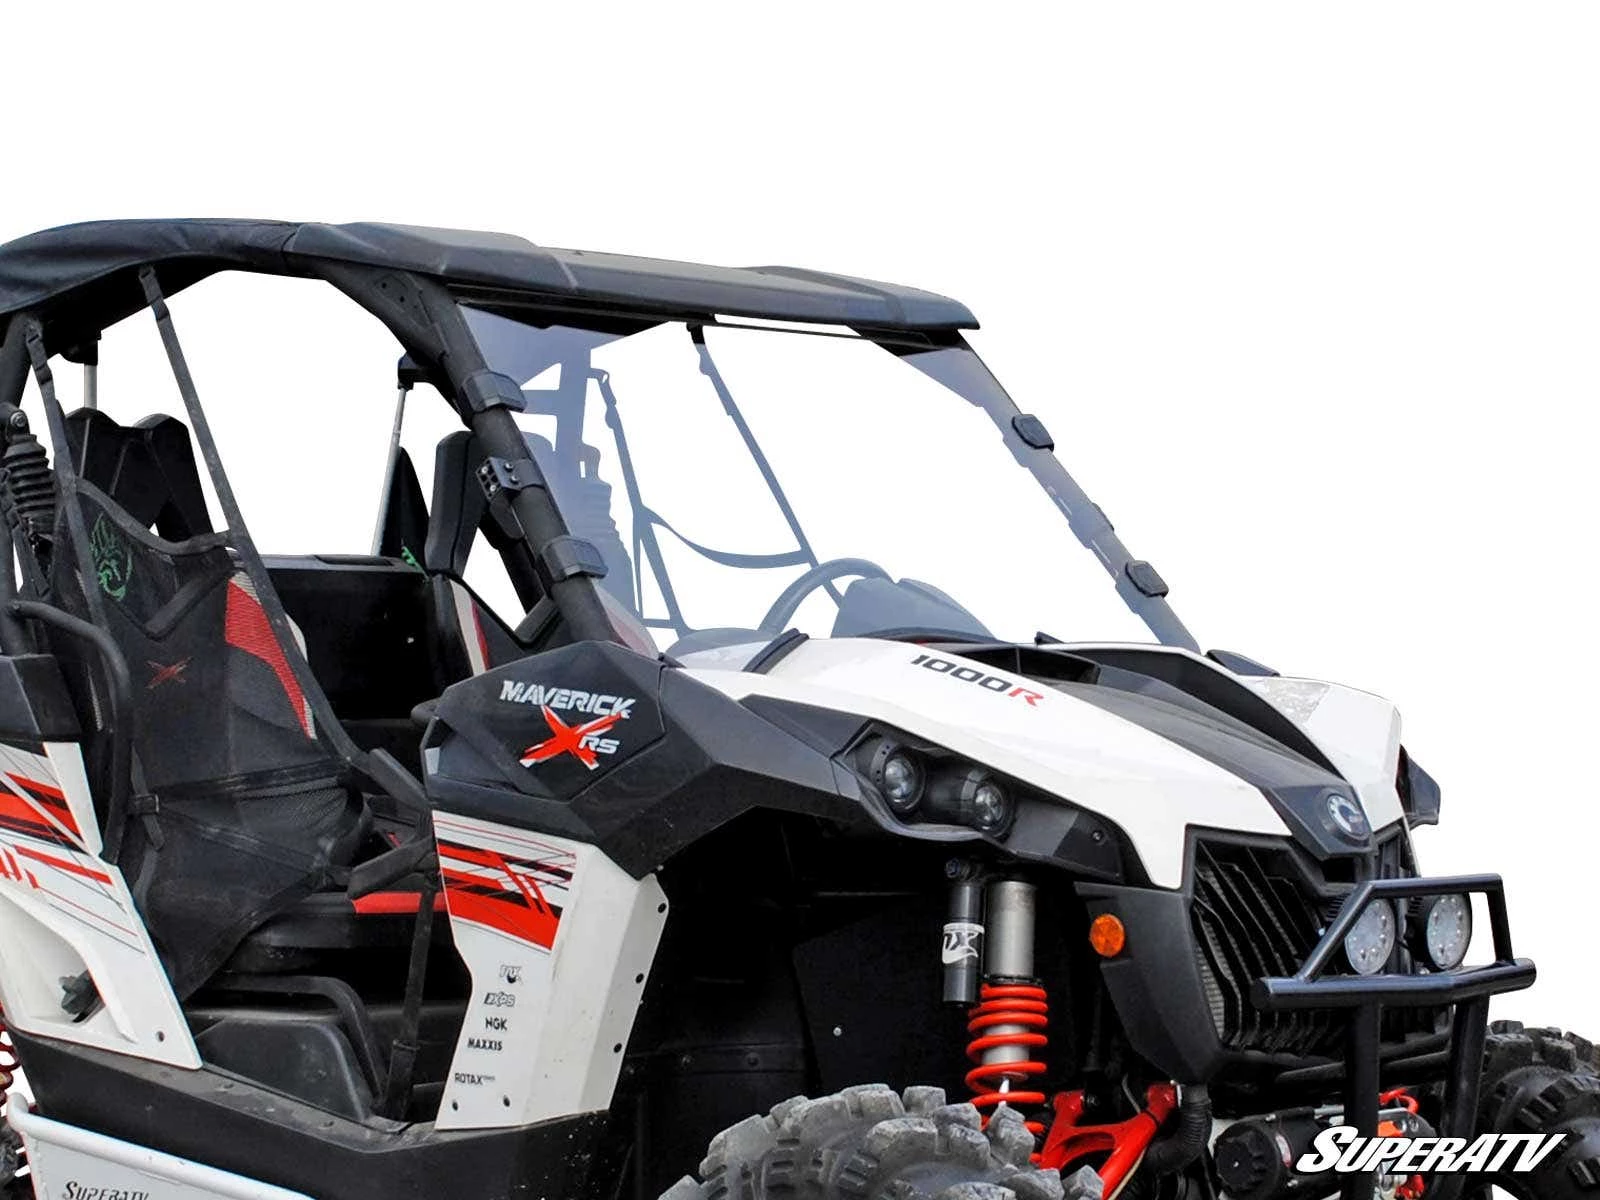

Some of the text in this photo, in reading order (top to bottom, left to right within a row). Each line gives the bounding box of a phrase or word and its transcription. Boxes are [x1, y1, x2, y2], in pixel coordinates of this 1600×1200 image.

[911, 654, 1044, 707] 1000R
[500, 680, 636, 719] MAVERICK
[485, 1017, 508, 1031] NGK
[467, 1037, 503, 1051] MAXXIS
[454, 1072, 483, 1086] ROTAX
